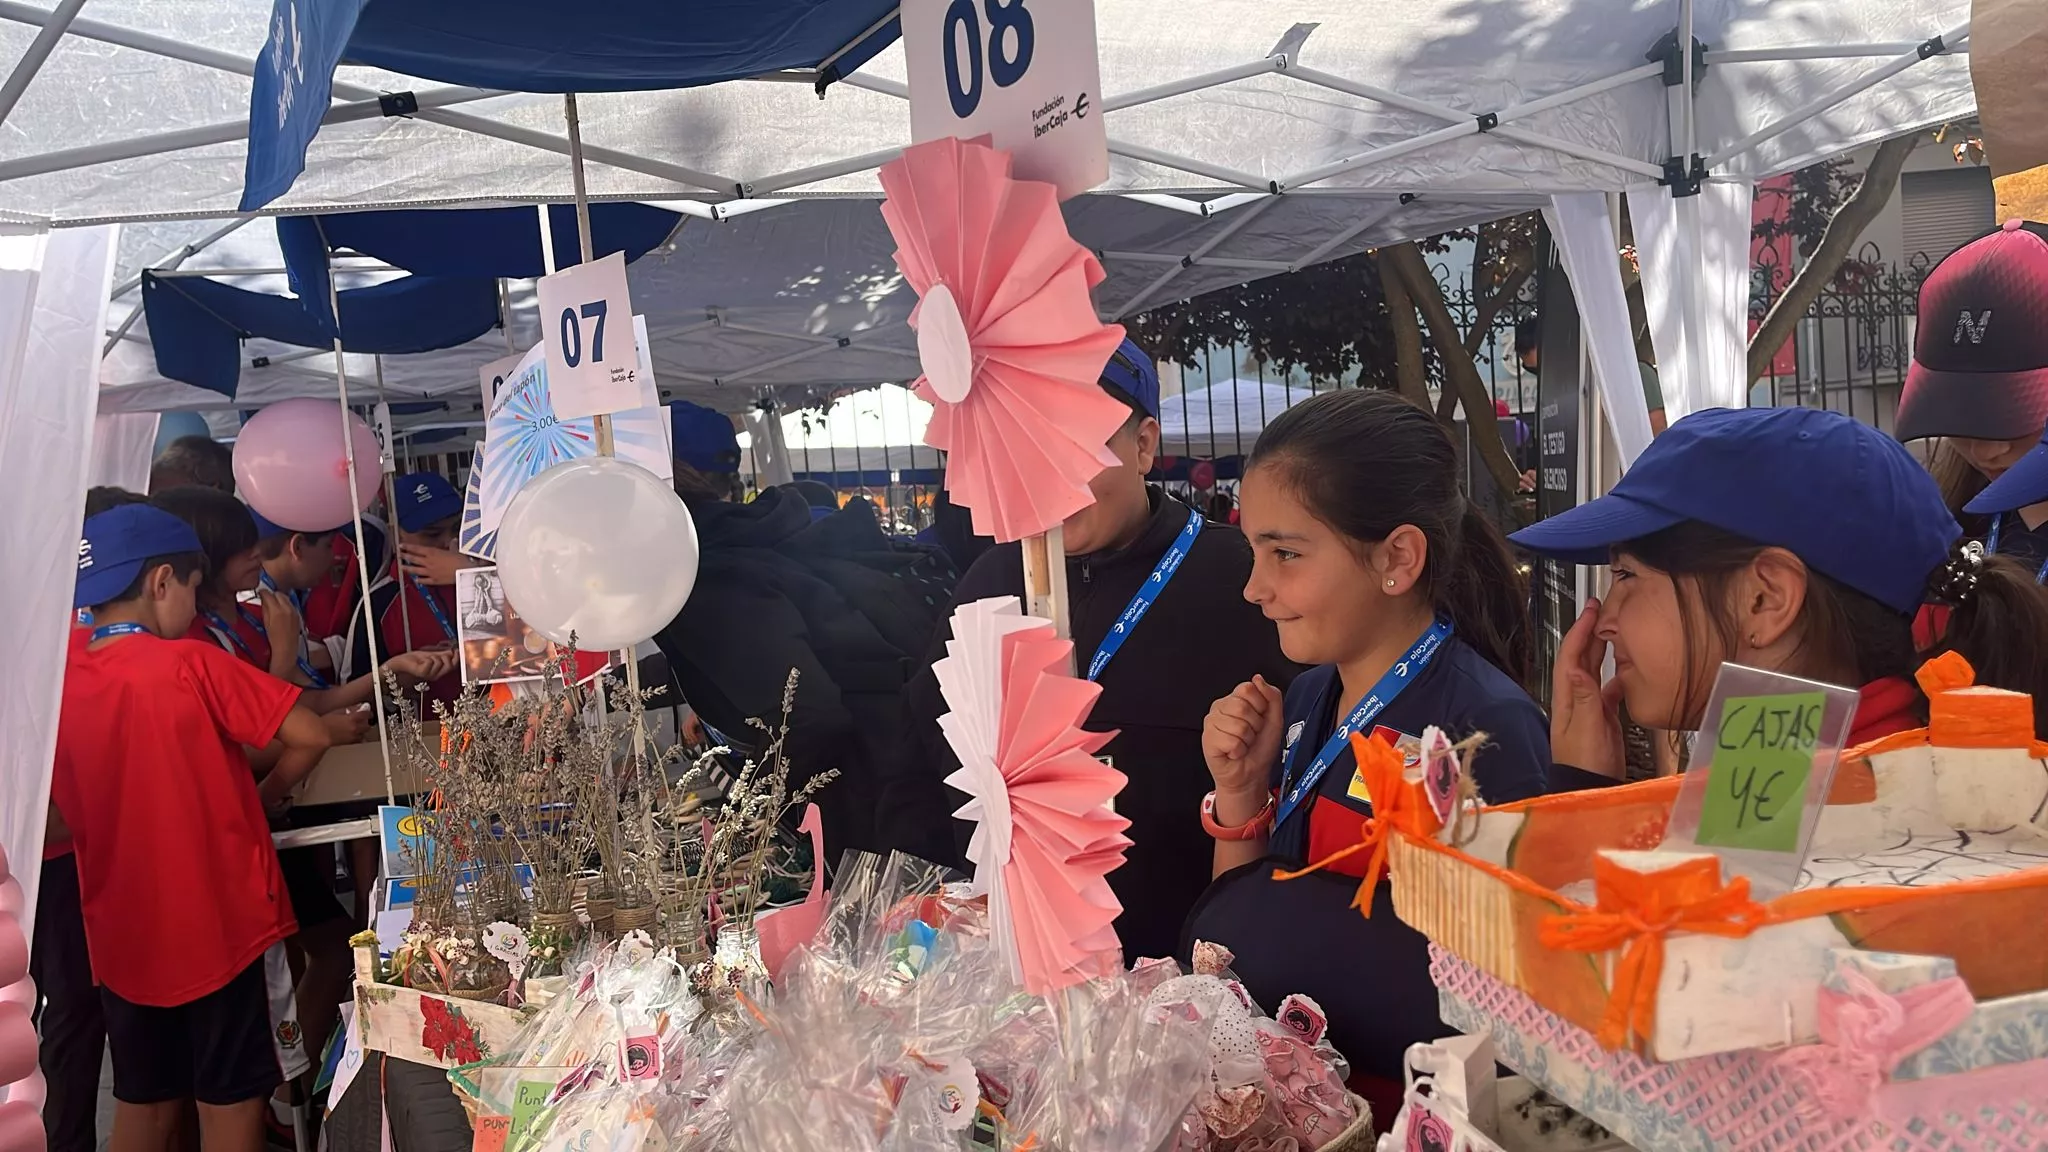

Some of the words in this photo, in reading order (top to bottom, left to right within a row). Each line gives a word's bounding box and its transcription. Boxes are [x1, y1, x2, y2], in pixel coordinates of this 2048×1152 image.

[943, 0, 1034, 119] 08
[1032, 95, 1064, 122] Fundación
[1034, 110, 1068, 139] iberCaja
[560, 299, 608, 369] 07
[1410, 633, 1437, 661] iberCaja
[1417, 641, 1442, 665] Fundación
[1350, 694, 1379, 724] iberCaja
[1356, 701, 1384, 728] Fundación
[1718, 704, 1822, 751] CAJAS
[519, 1086, 547, 1106] Punt
